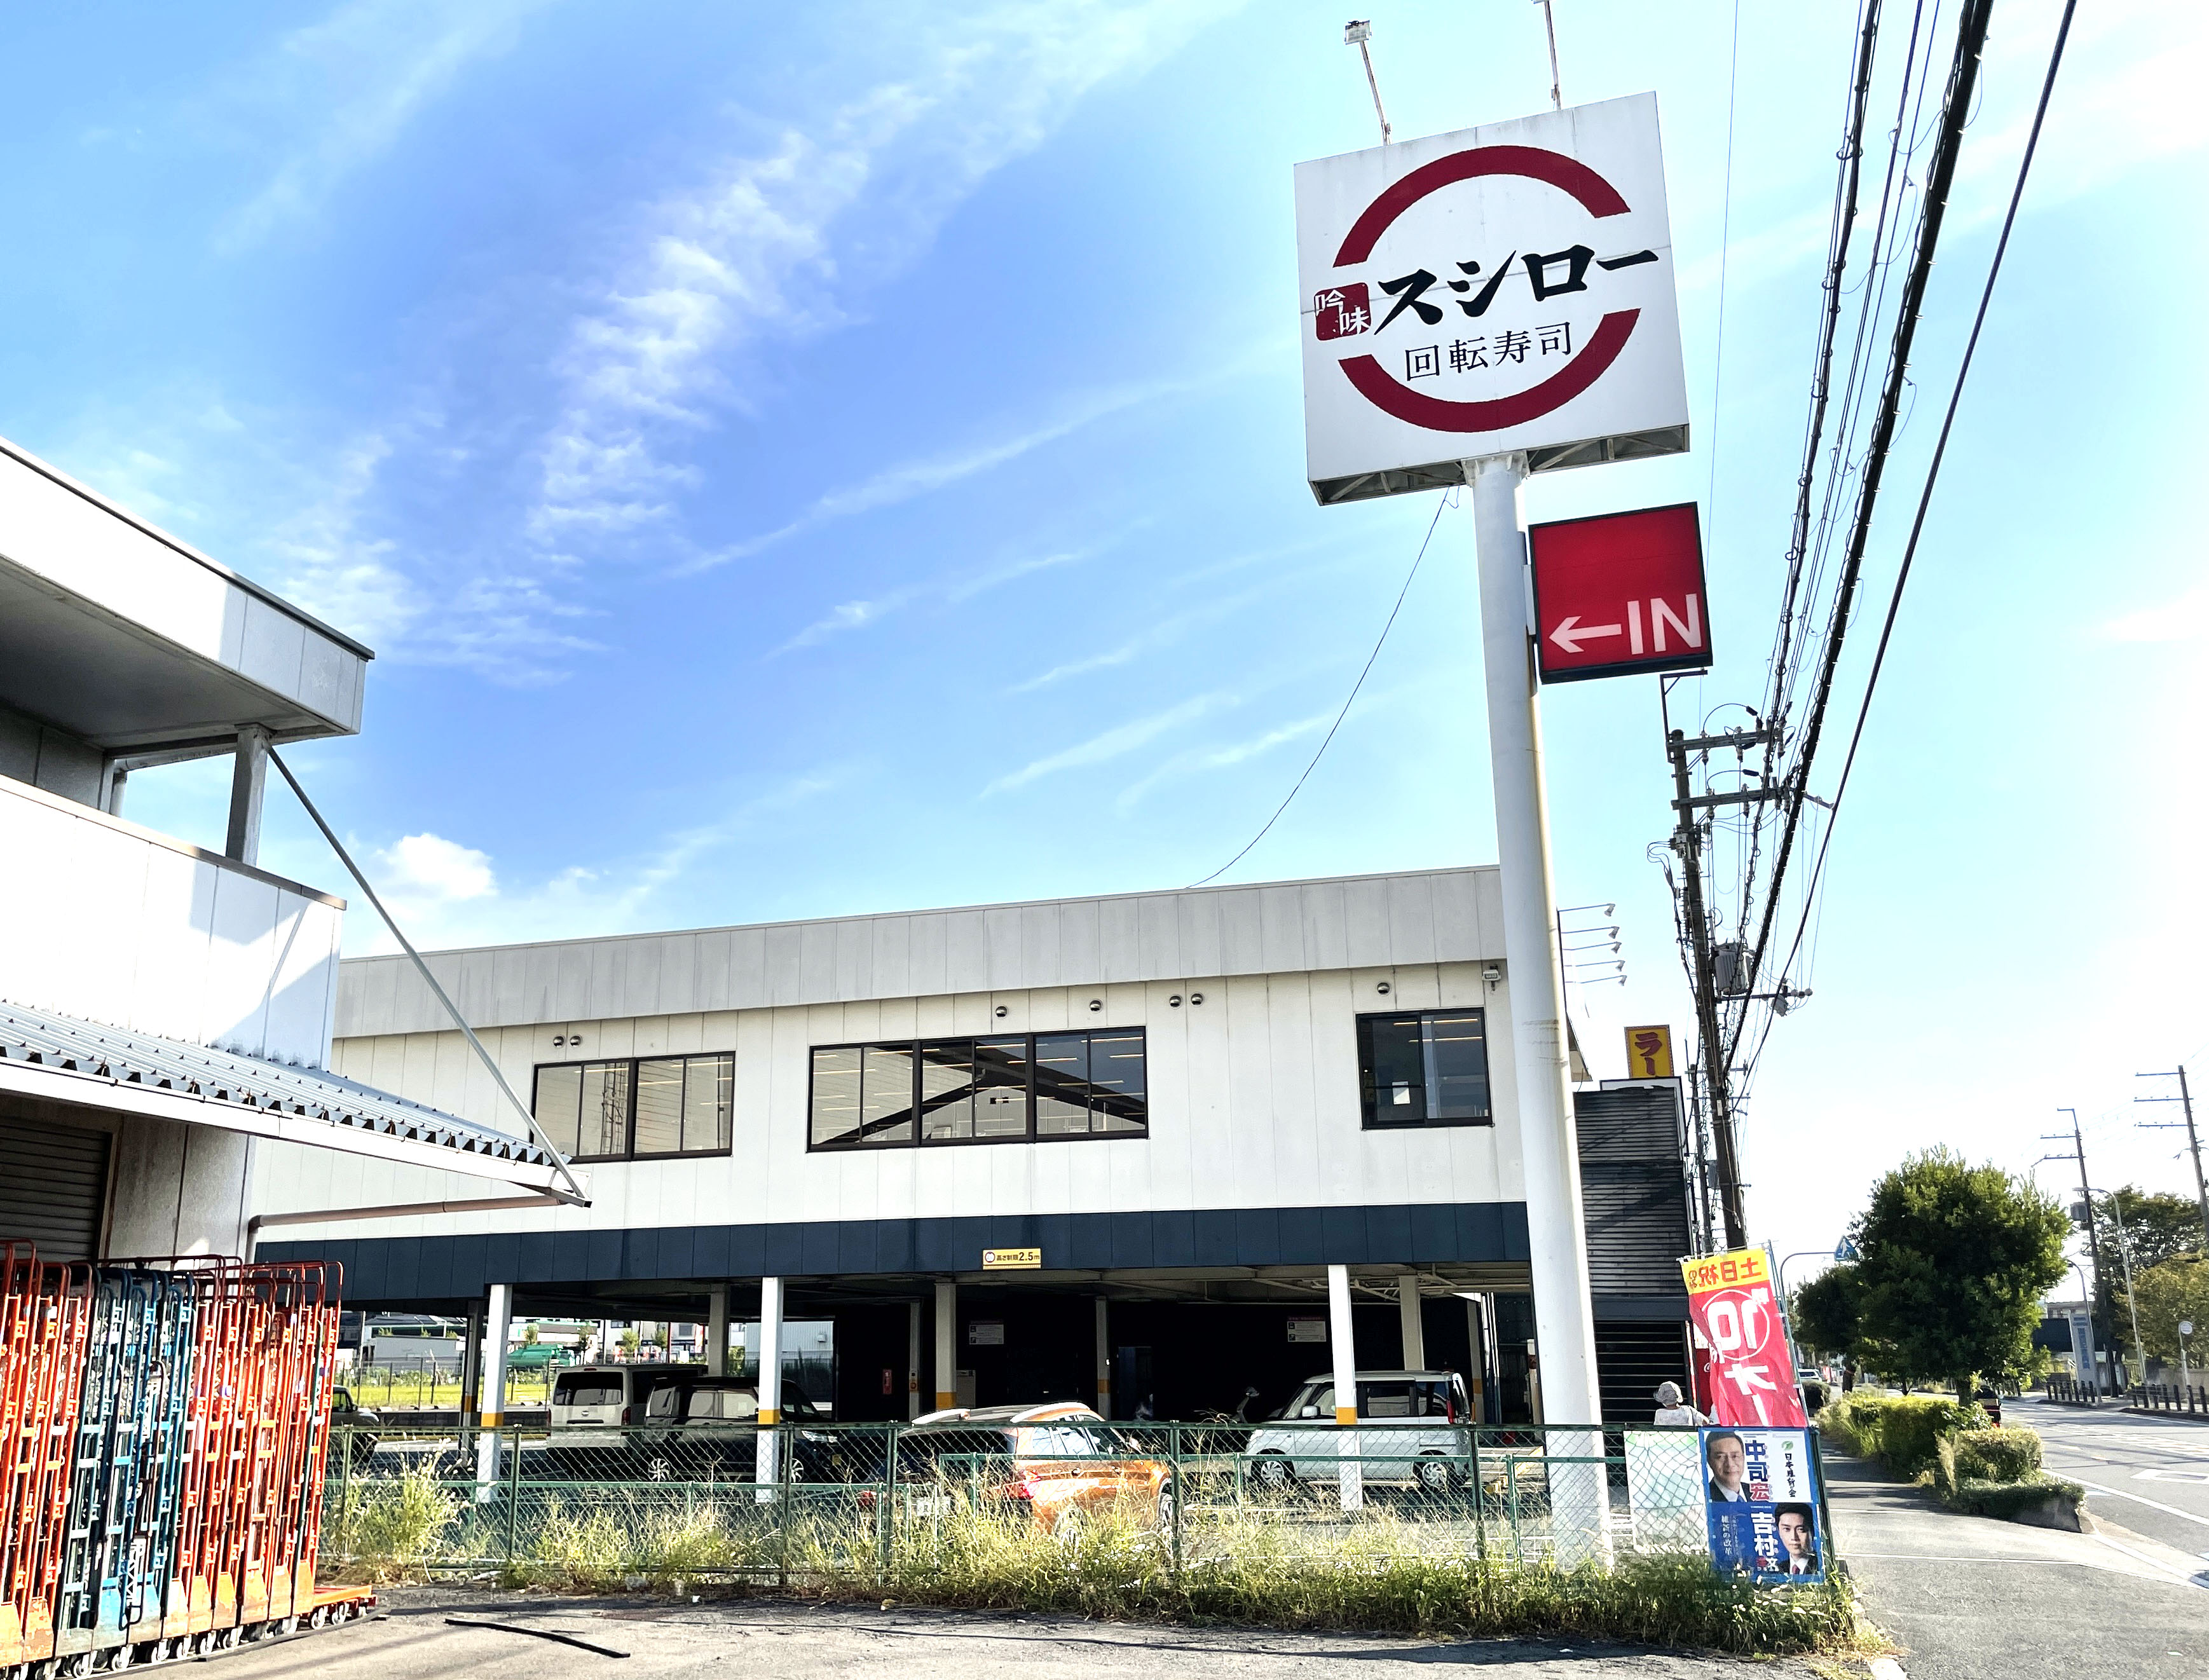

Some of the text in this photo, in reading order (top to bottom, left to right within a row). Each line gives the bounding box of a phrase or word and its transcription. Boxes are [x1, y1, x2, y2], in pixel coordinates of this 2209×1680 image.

[1314, 289, 1370, 336] 吟味
[1374, 245, 1658, 335] スシロー
[1404, 322, 1571, 381] 回転寿司
[1627, 593, 1702, 655] IN
[1634, 1032, 1662, 1076] ラー
[1745, 1440, 1770, 1501] 中司宏
